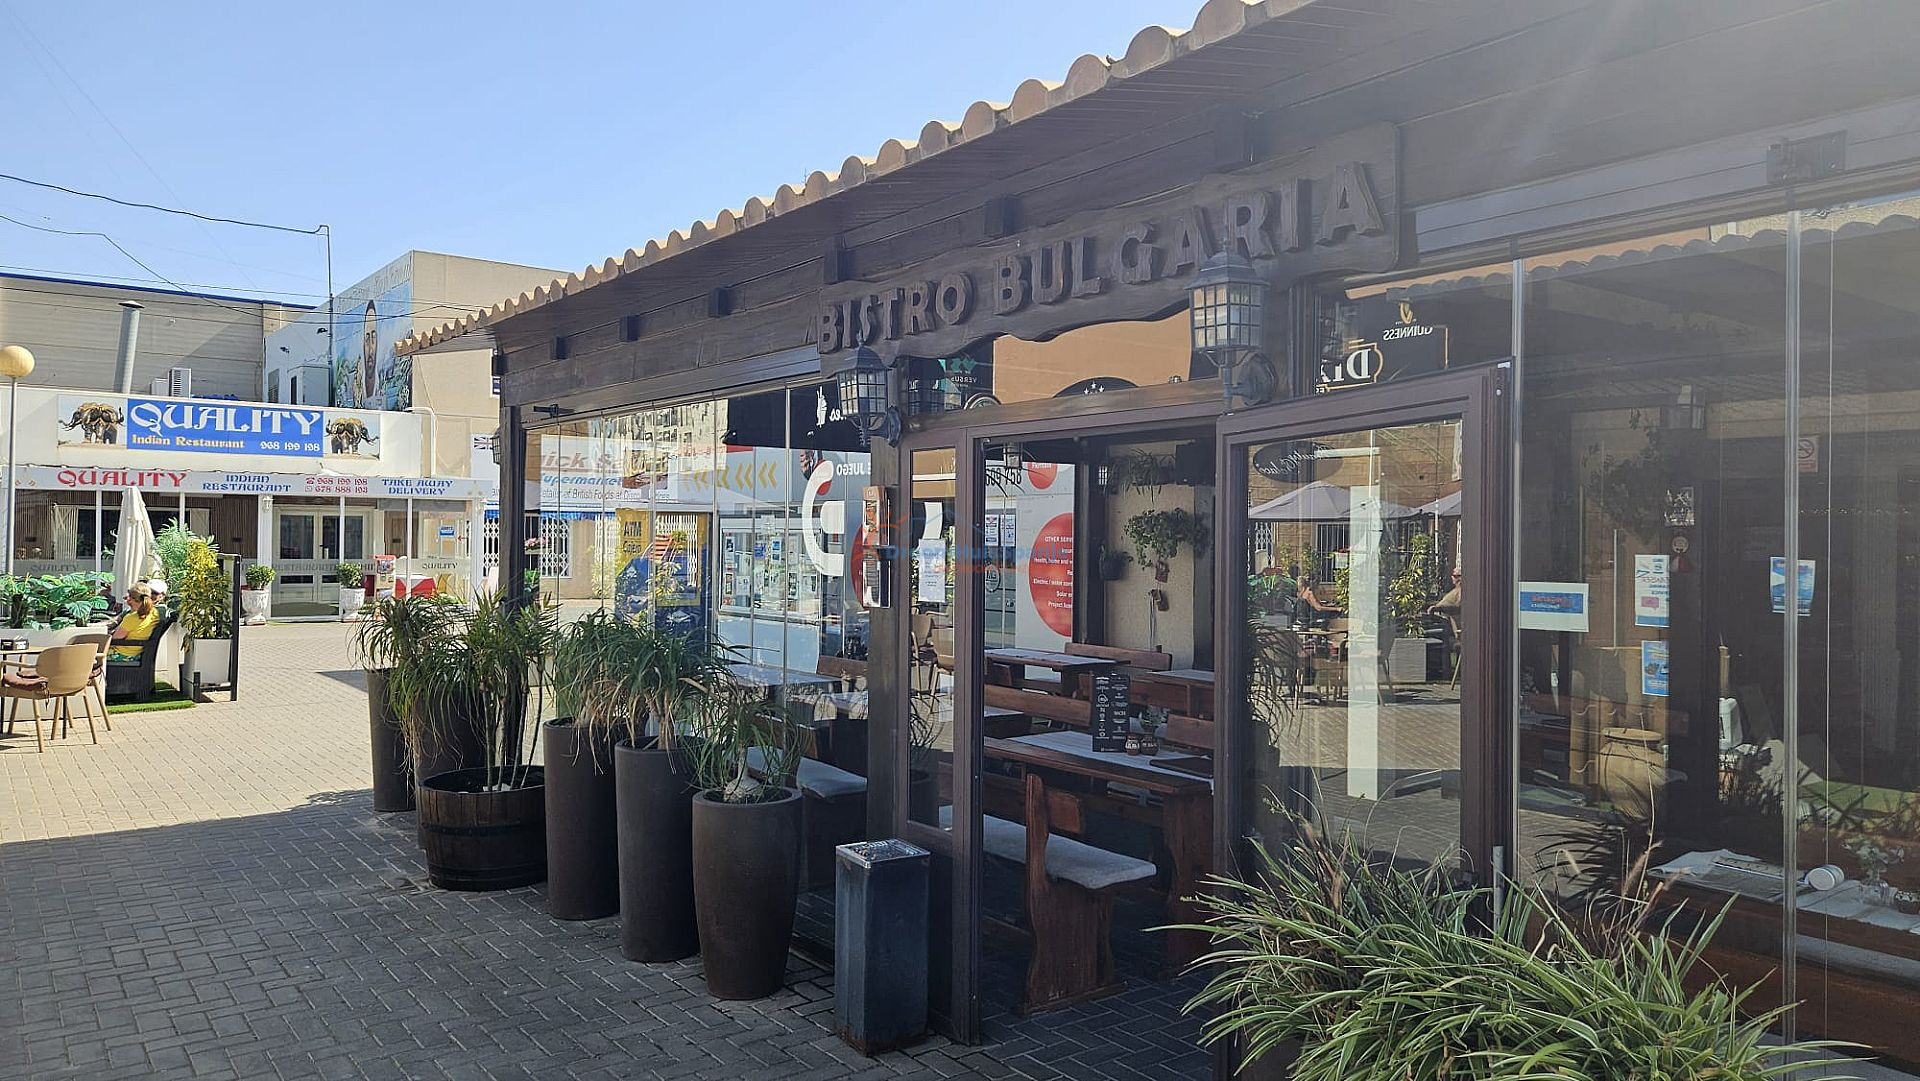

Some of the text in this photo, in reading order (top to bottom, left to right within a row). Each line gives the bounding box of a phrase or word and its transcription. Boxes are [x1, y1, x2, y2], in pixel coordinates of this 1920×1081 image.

[818, 161, 1385, 354] BISTRO BULGARIA
[130, 402, 322, 437] QUALITY
[132, 434, 246, 449] Indian Restaurant
[260, 440, 321, 452] 968 199 198
[57, 469, 188, 488] QUALITY
[226, 474, 270, 483] INDIAN
[317, 477, 334, 485] 968
[381, 478, 454, 488] TAKE AWAY
[542, 473, 623, 487] upermarket
[202, 483, 292, 492] RESTAURANT
[388, 487, 446, 496] DELIVERY
[624, 521, 642, 537] ATM
[421, 562, 458, 570] QUALITY
